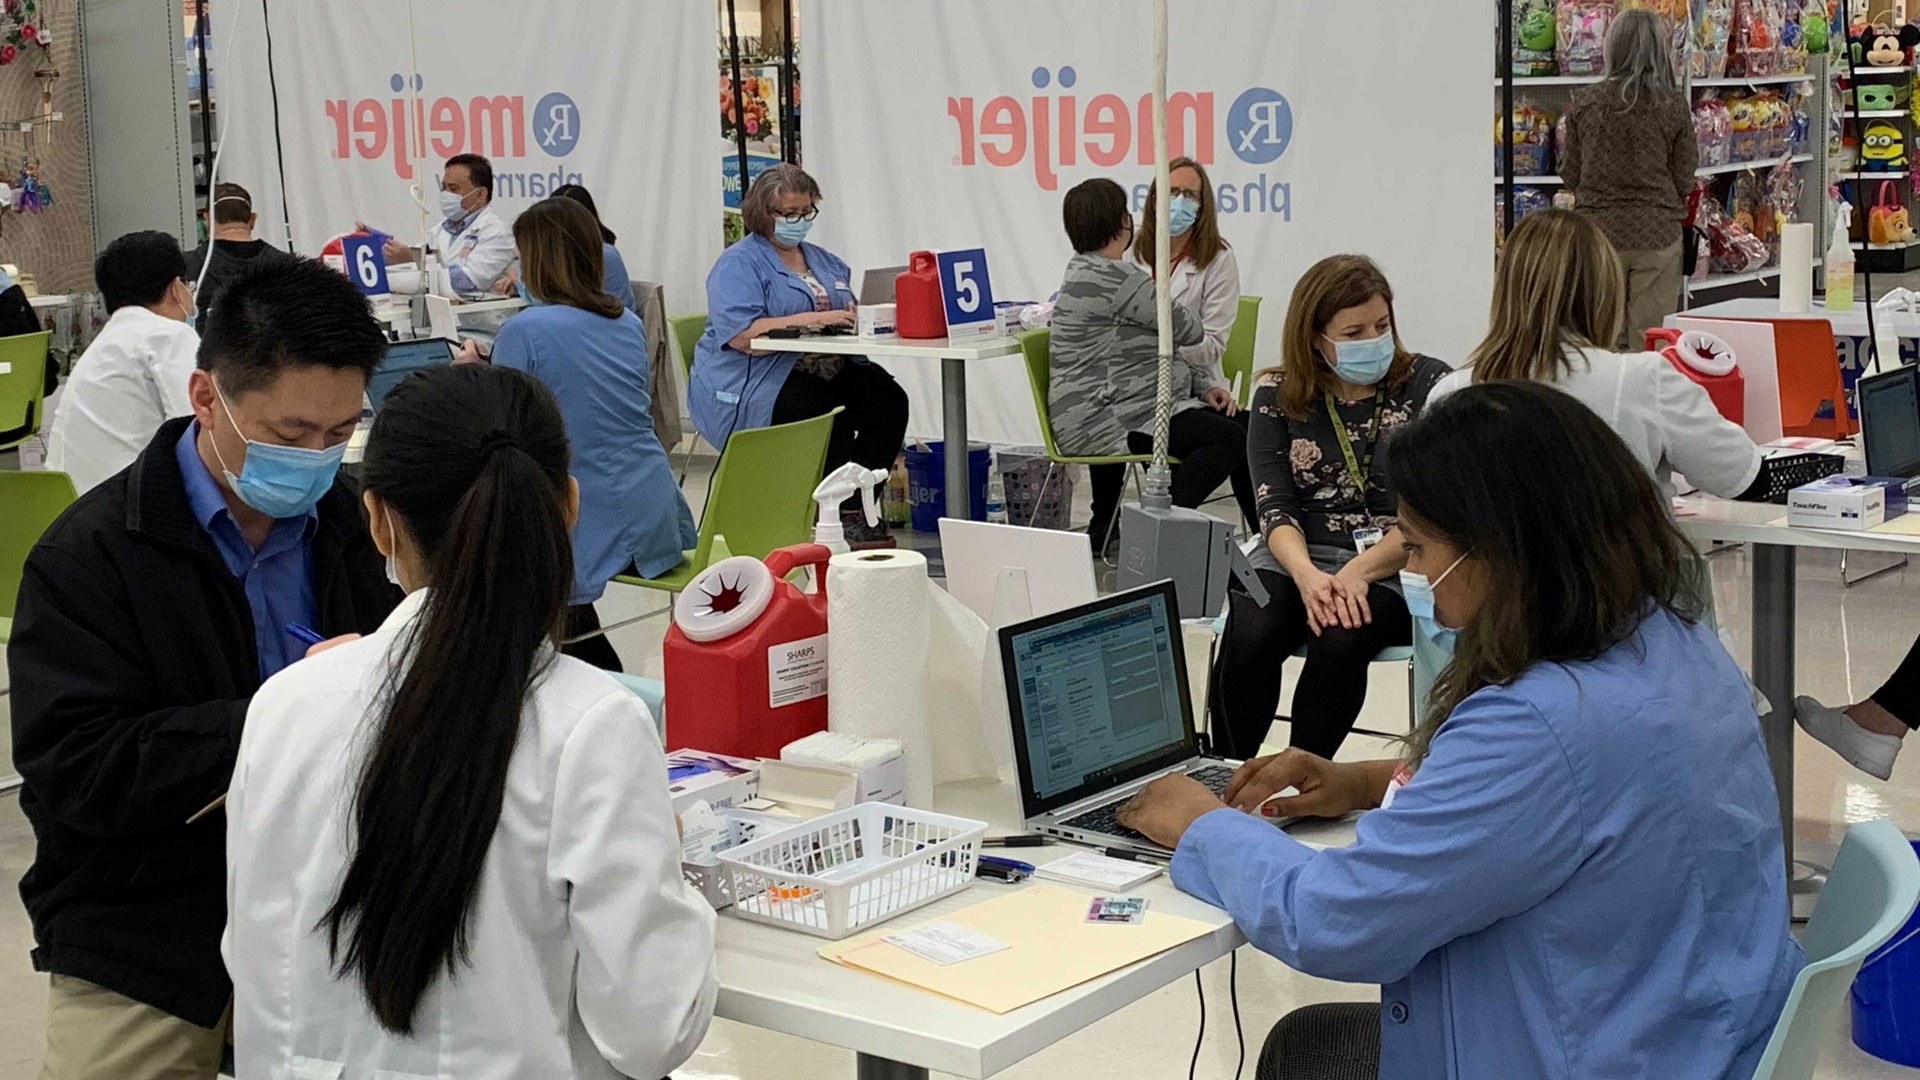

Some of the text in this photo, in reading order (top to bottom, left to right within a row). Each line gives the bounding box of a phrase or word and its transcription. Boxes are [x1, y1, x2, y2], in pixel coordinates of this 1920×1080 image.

[356, 244, 379, 288] 6
[953, 260, 981, 313] 5
[787, 646, 815, 661] SHARPS
